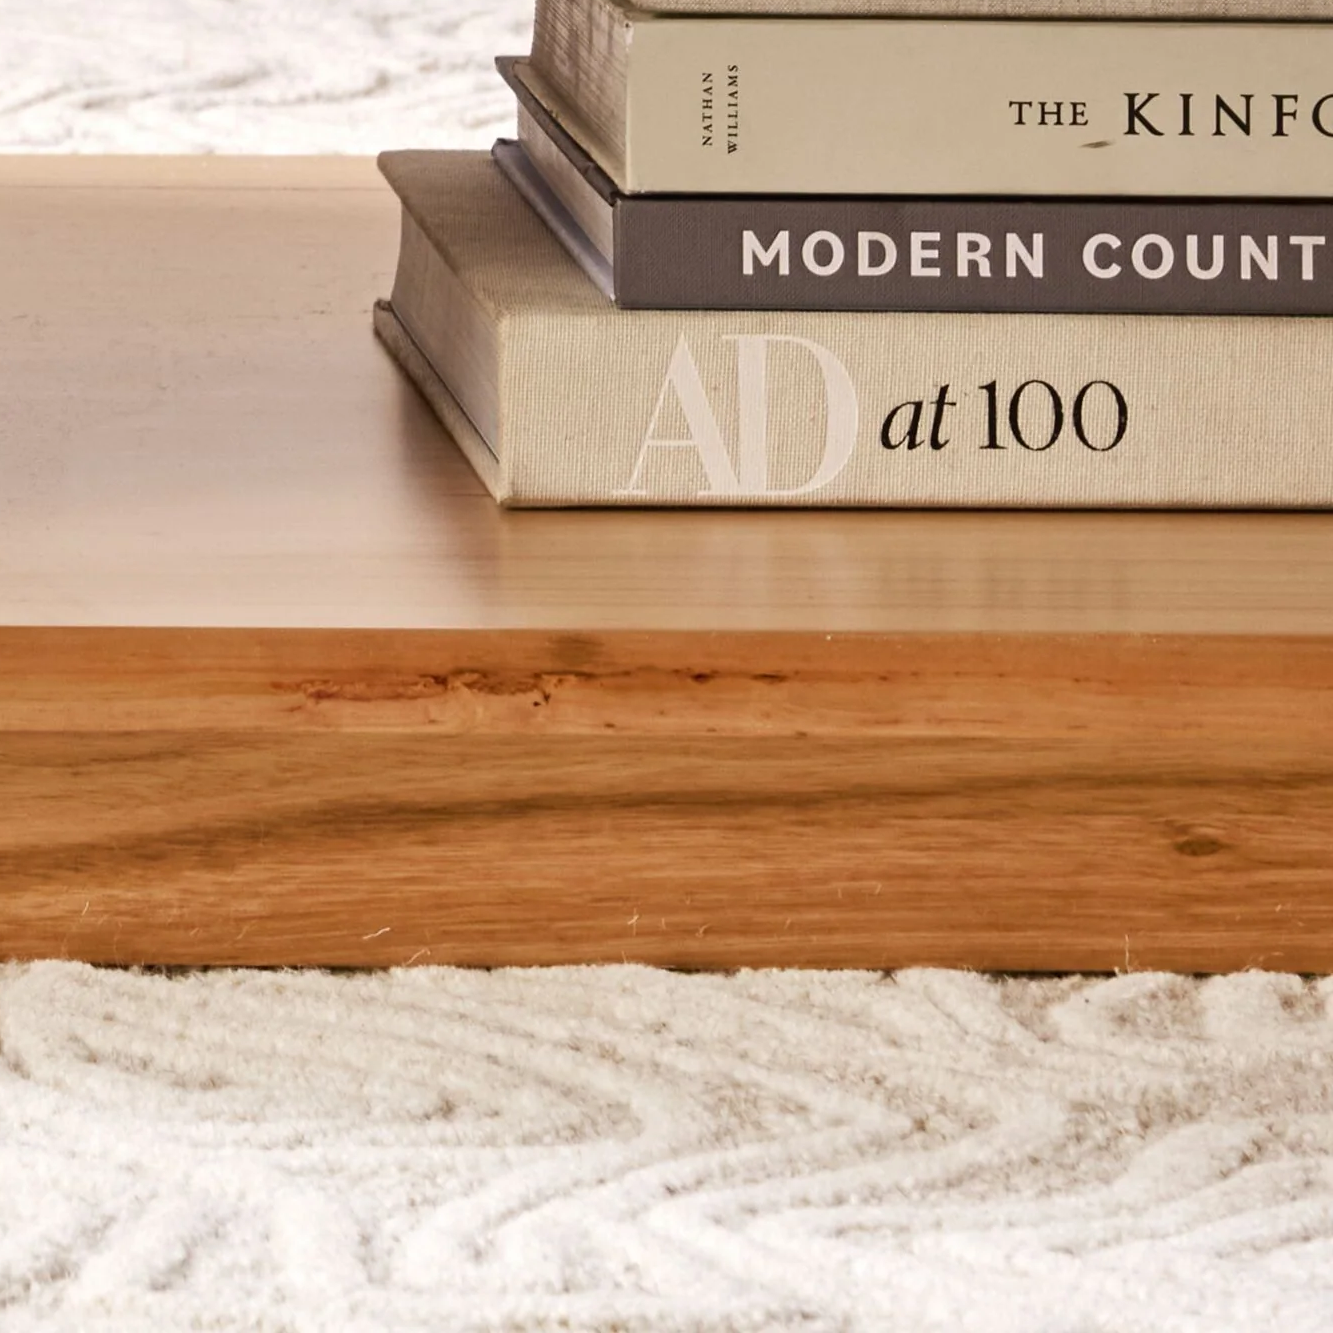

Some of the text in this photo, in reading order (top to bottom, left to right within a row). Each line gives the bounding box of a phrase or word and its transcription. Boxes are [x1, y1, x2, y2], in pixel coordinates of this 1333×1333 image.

[701, 72, 713, 146] NATHAN
[727, 64, 739, 154] WILLIAMS
[1008, 99, 1090, 126] THE
[742, 229, 1327, 282] MODERN COUNT
[612, 332, 1129, 496] AD at 100
